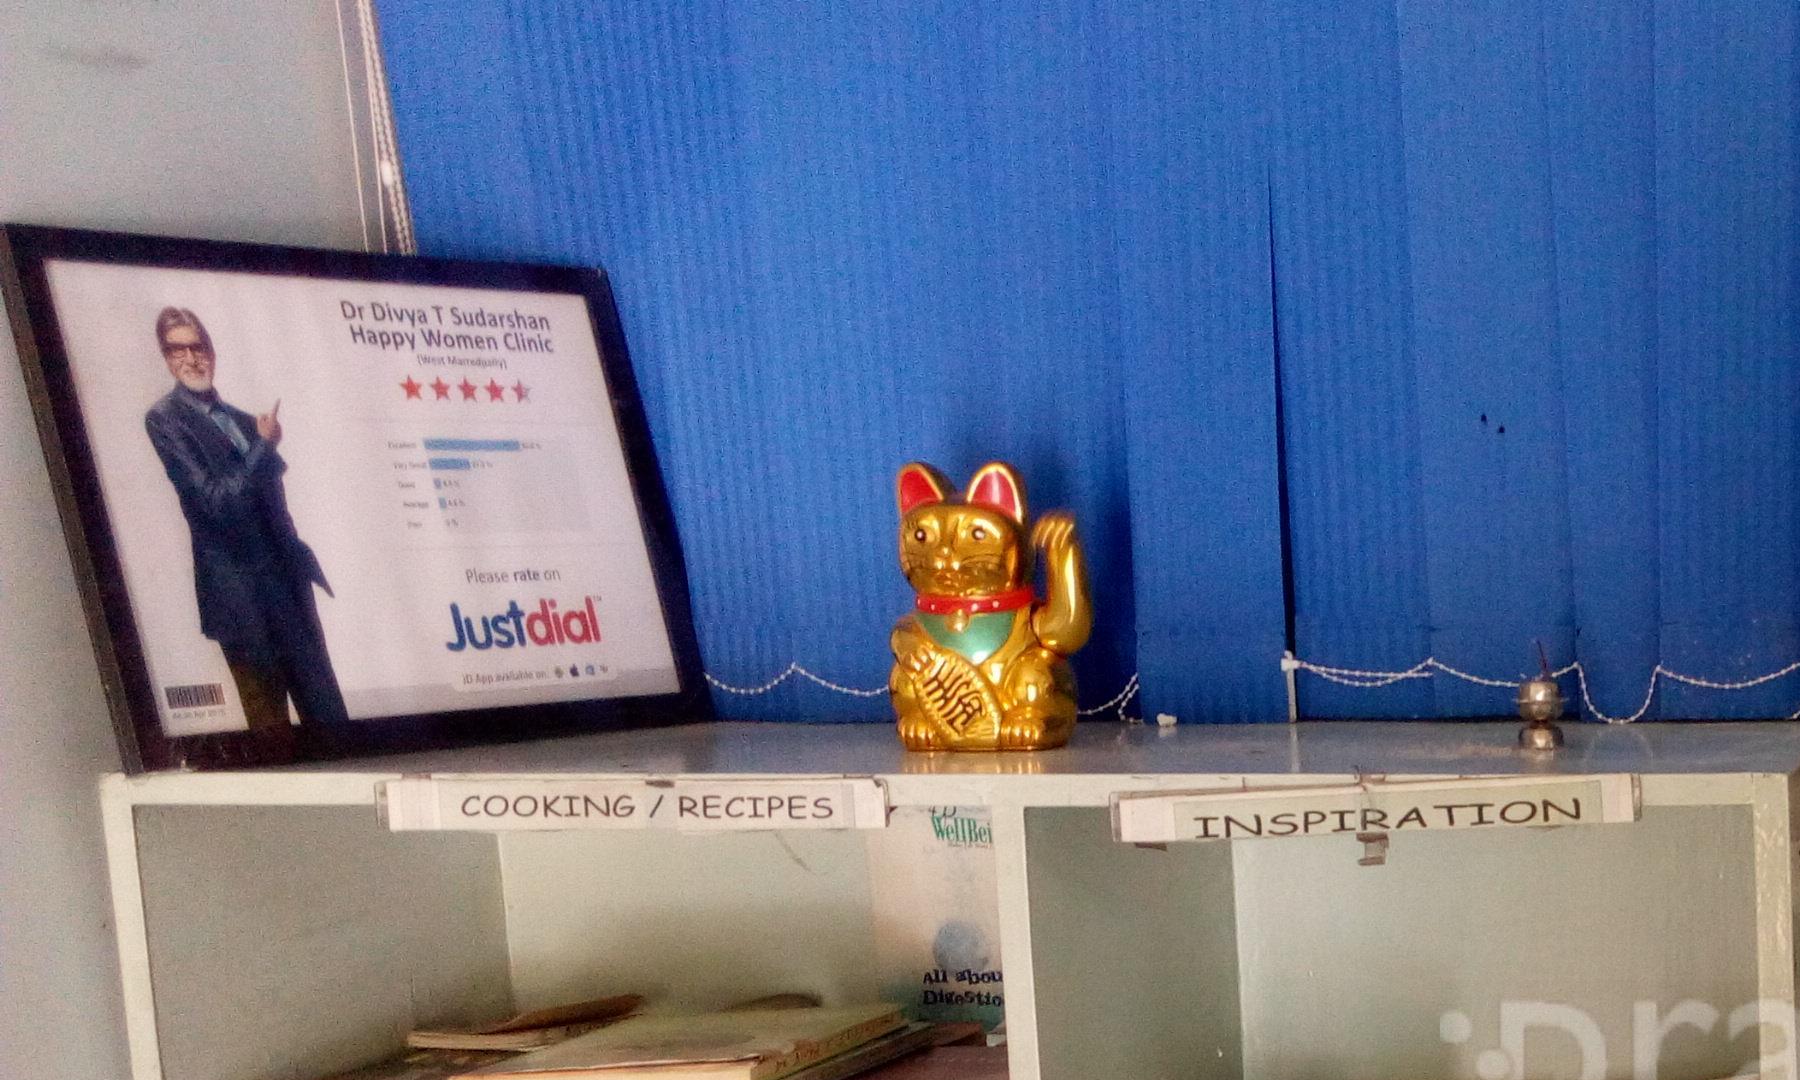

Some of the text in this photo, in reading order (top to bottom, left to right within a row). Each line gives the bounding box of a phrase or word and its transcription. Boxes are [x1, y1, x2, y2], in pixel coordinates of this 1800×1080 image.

[341, 301, 550, 331] Dr Divya T Sudarshan
[350, 325, 555, 353] Happy Women Clinic
[466, 568, 561, 584] Please rate on
[446, 595, 602, 653] Justdial
[461, 794, 636, 819] COOKING
[677, 794, 834, 821] RECIPES
[1194, 797, 1582, 839] INSPIRATION
[923, 968, 948, 984] All
